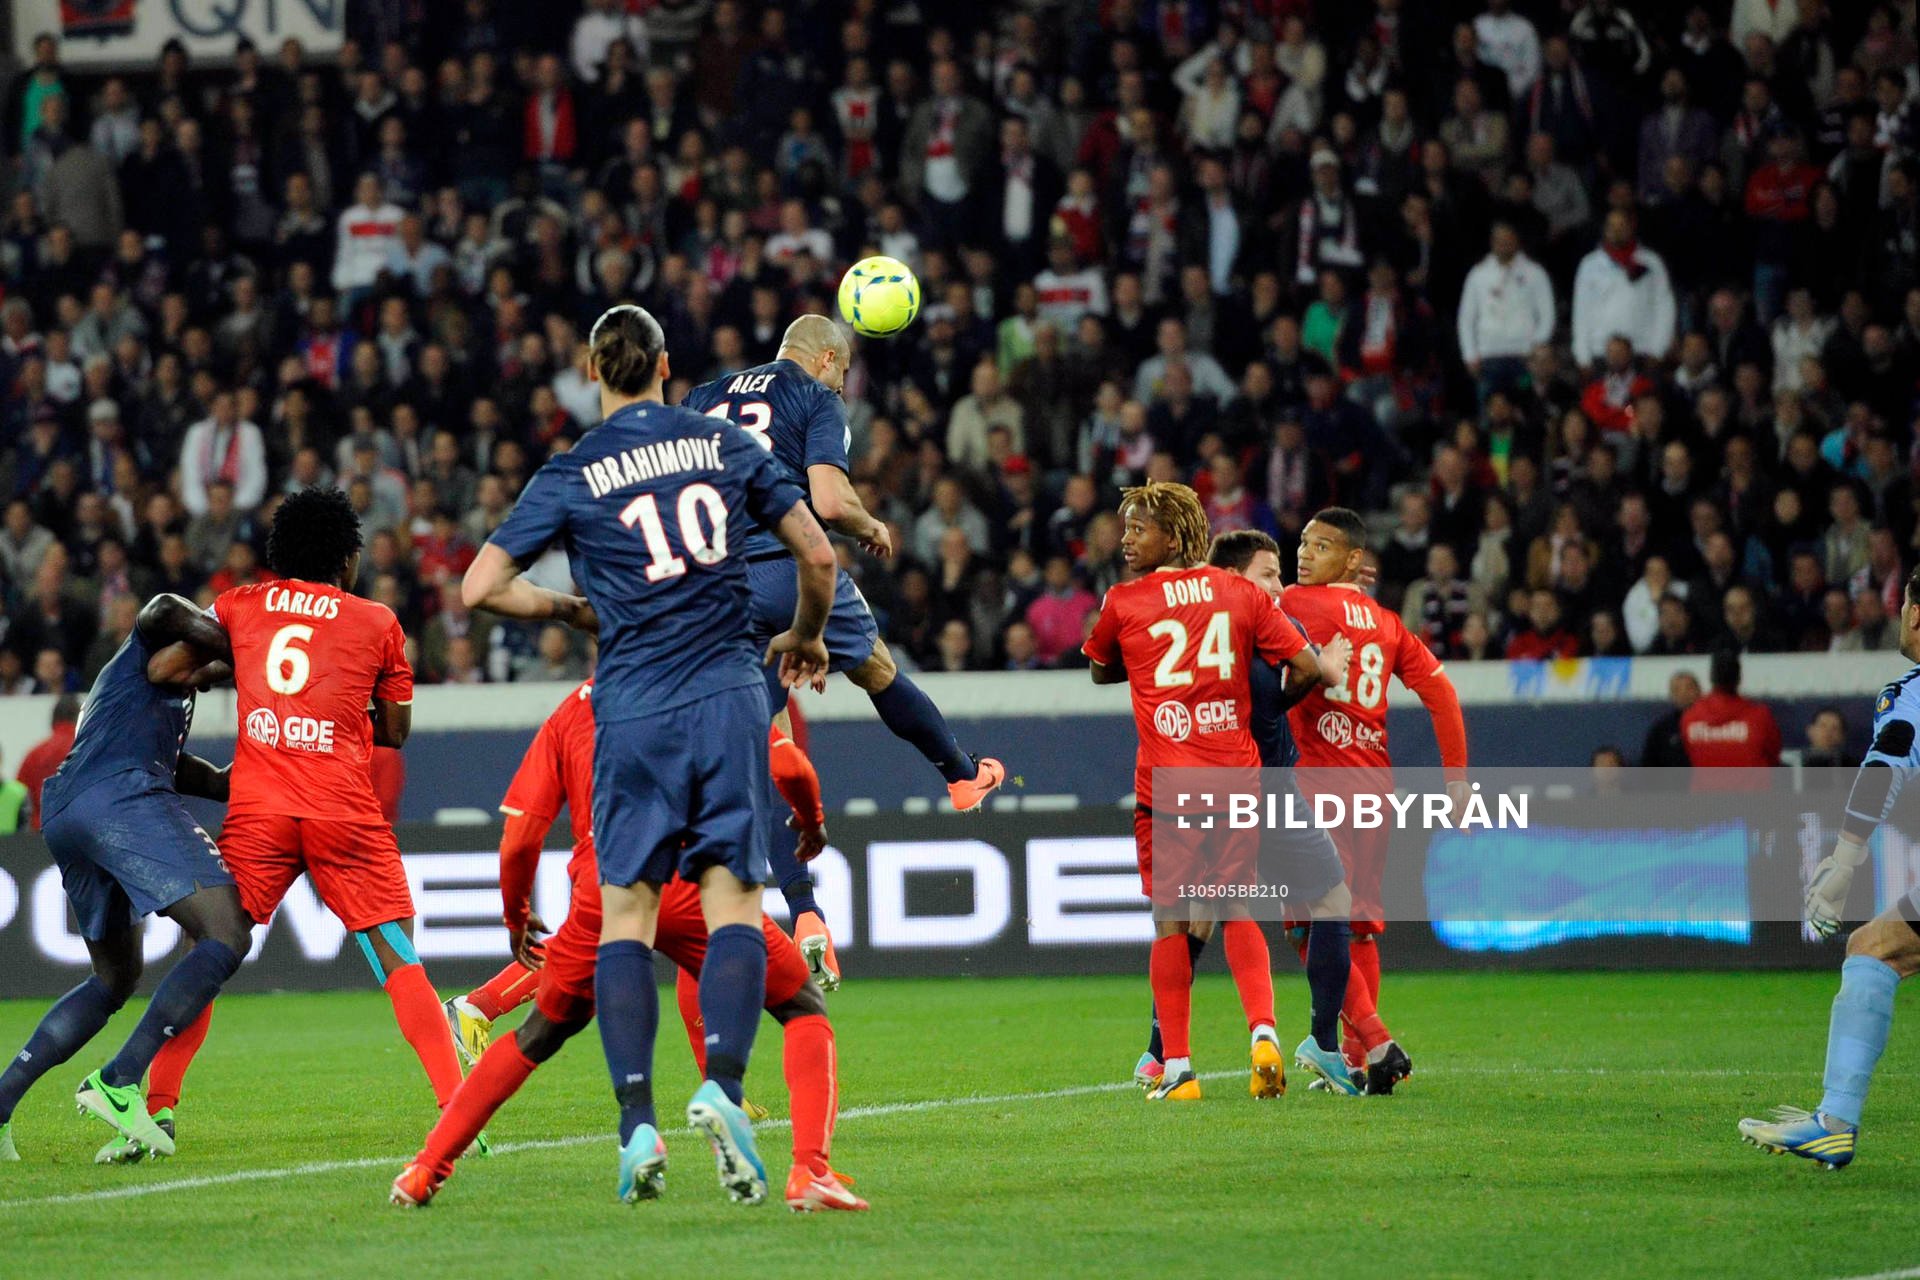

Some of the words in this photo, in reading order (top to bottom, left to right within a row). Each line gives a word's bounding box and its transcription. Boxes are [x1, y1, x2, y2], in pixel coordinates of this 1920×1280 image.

[727, 374, 776, 394] ALEX
[582, 432, 725, 499] IBRAHIMOVIĆ
[618, 481, 729, 584] 10
[265, 586, 342, 620] CARLOS
[1162, 576, 1214, 609] BONG
[265, 623, 314, 696] 6
[1147, 610, 1236, 688] 24
[1195, 699, 1237, 725] GDE
[1199, 721, 1239, 735] RECYCLAGE
[284, 716, 335, 745] GDE
[286, 740, 335, 753] RECYCLAGE
